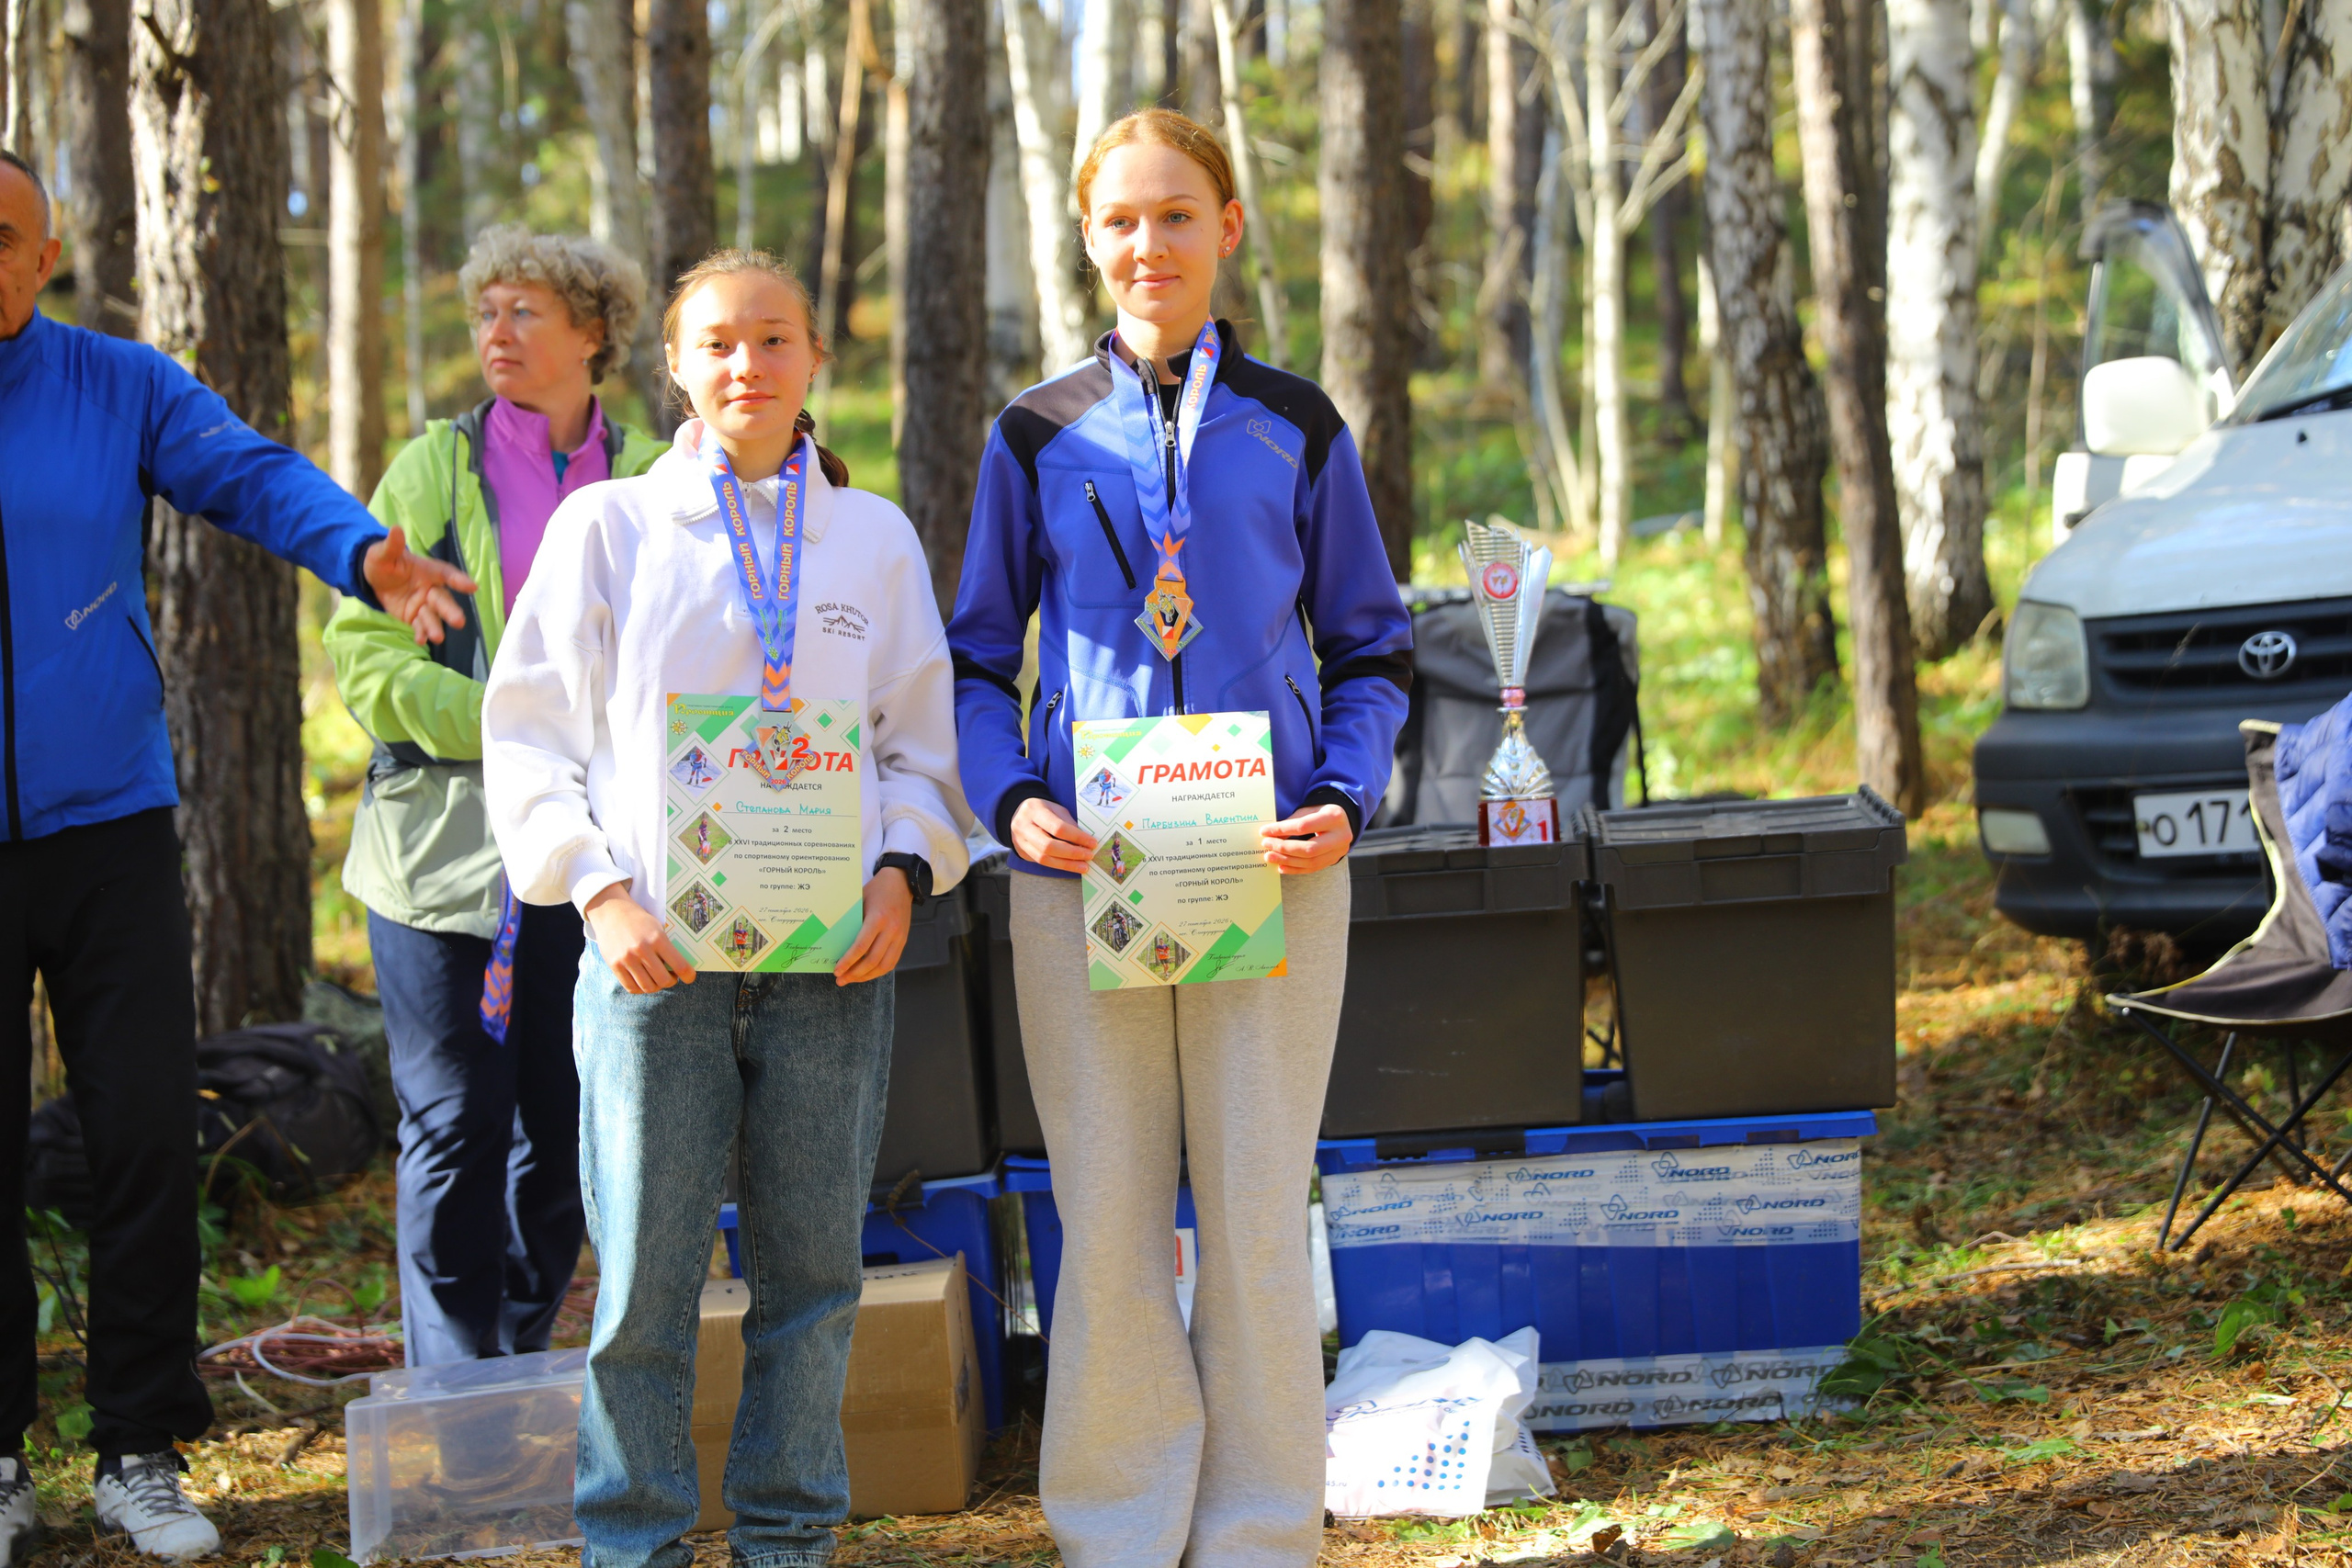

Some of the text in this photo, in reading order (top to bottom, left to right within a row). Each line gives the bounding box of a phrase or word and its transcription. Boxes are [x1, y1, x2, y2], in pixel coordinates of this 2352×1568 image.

[1252, 432, 1298, 468] NORD
[783, 481, 798, 537] КОРОЛЬ
[722, 481, 764, 600] ГОРНЫЙ КОРОЛЬ
[777, 543, 793, 600] ГОРНЫЙ
[84, 581, 117, 616] NORD
[815, 603, 869, 626] ROSA KHUTOR
[838, 629, 865, 641] RESORT
[791, 737, 809, 759] 2
[728, 748, 854, 772] ГРОТА
[786, 754, 815, 780] КОРОЛЬ
[1137, 758, 1266, 784] ГРАМОТА
[760, 782, 822, 791] НАЖДАЕТСЯ
[1171, 792, 1235, 802] НАГРАЖДАЕТСЯ
[799, 803, 831, 815] Мария
[1204, 813, 1259, 826] Валентина
[784, 825, 789, 833] 2
[1537, 819, 1548, 841] 1
[744, 853, 789, 862] спортивному
[1166, 853, 1217, 862] традиционных
[1159, 867, 1205, 875] спортивному
[1206, 863, 1268, 873] ориентированию
[1175, 879, 1209, 887] «ГОРНЫЙ
[1814, 1151, 1860, 1164] NOR
[1532, 1169, 1595, 1180] NORD
[1668, 1167, 1730, 1177] NORD
[1351, 1201, 1413, 1215] NORD
[1762, 1199, 1825, 1210] NORD
[1481, 1211, 1544, 1223] NORD
[1618, 1210, 1679, 1221] NORD
[1340, 1224, 1400, 1239] NORD
[1733, 1226, 1794, 1236] NORD
[1596, 1371, 1691, 1386] NORD
[1540, 1402, 1635, 1416] NORD
